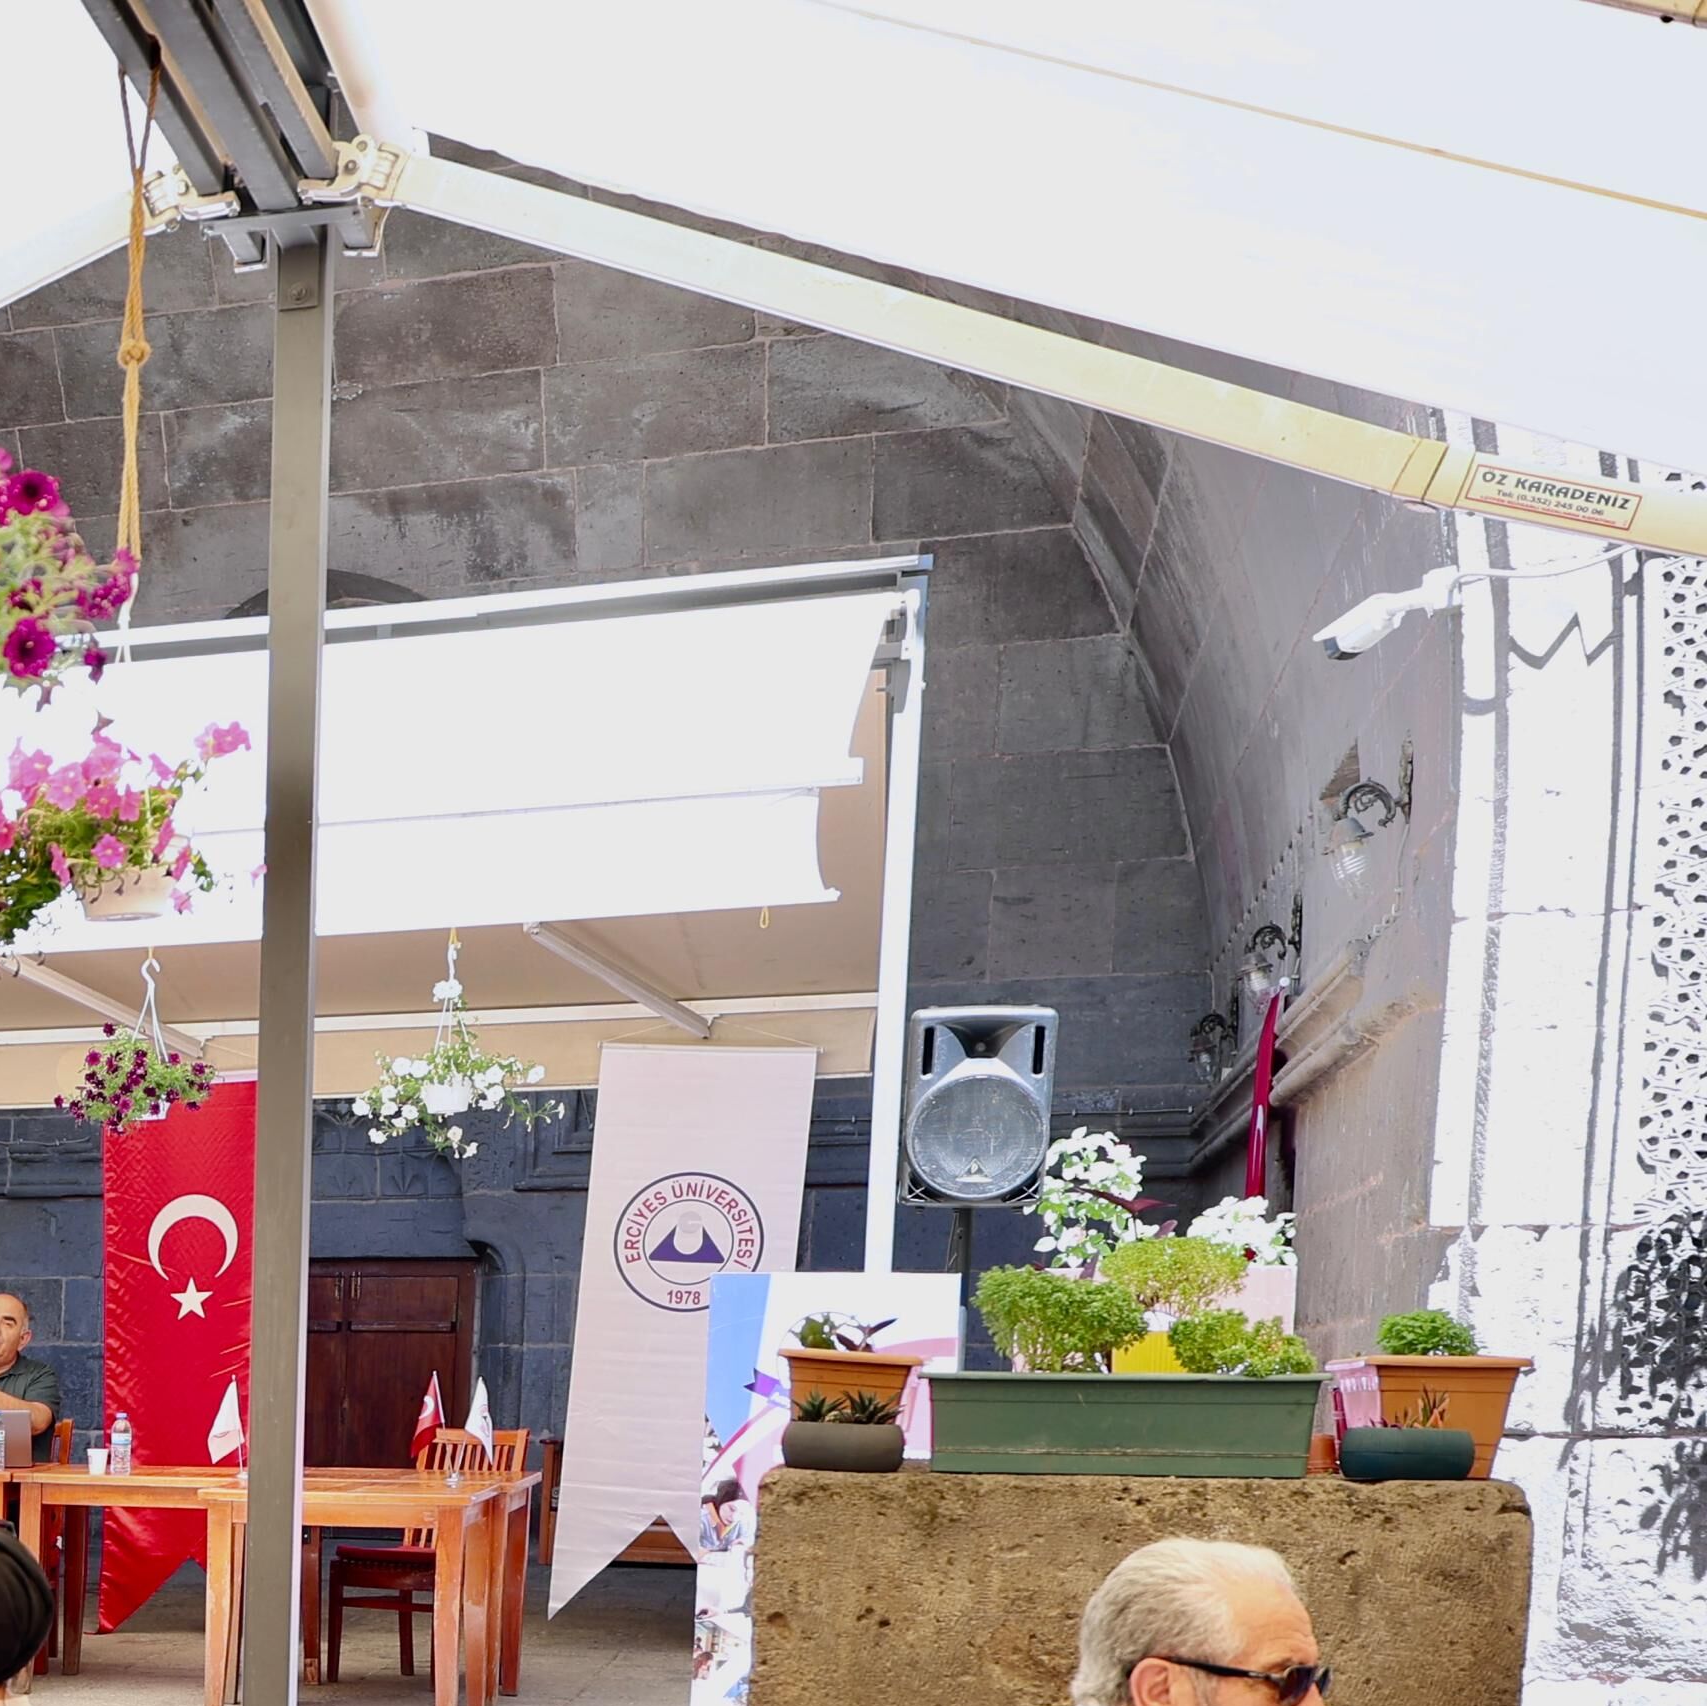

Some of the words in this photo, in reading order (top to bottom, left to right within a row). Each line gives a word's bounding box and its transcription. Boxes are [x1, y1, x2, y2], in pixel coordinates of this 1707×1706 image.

[1481, 468, 1509, 486] ÖZ
[1514, 476, 1632, 511] KARADENİZ
[624, 1190, 668, 1264] ERCİYES
[670, 1179, 755, 1270] ÜNİVERSİTESİ
[666, 1289, 701, 1305] 1978
